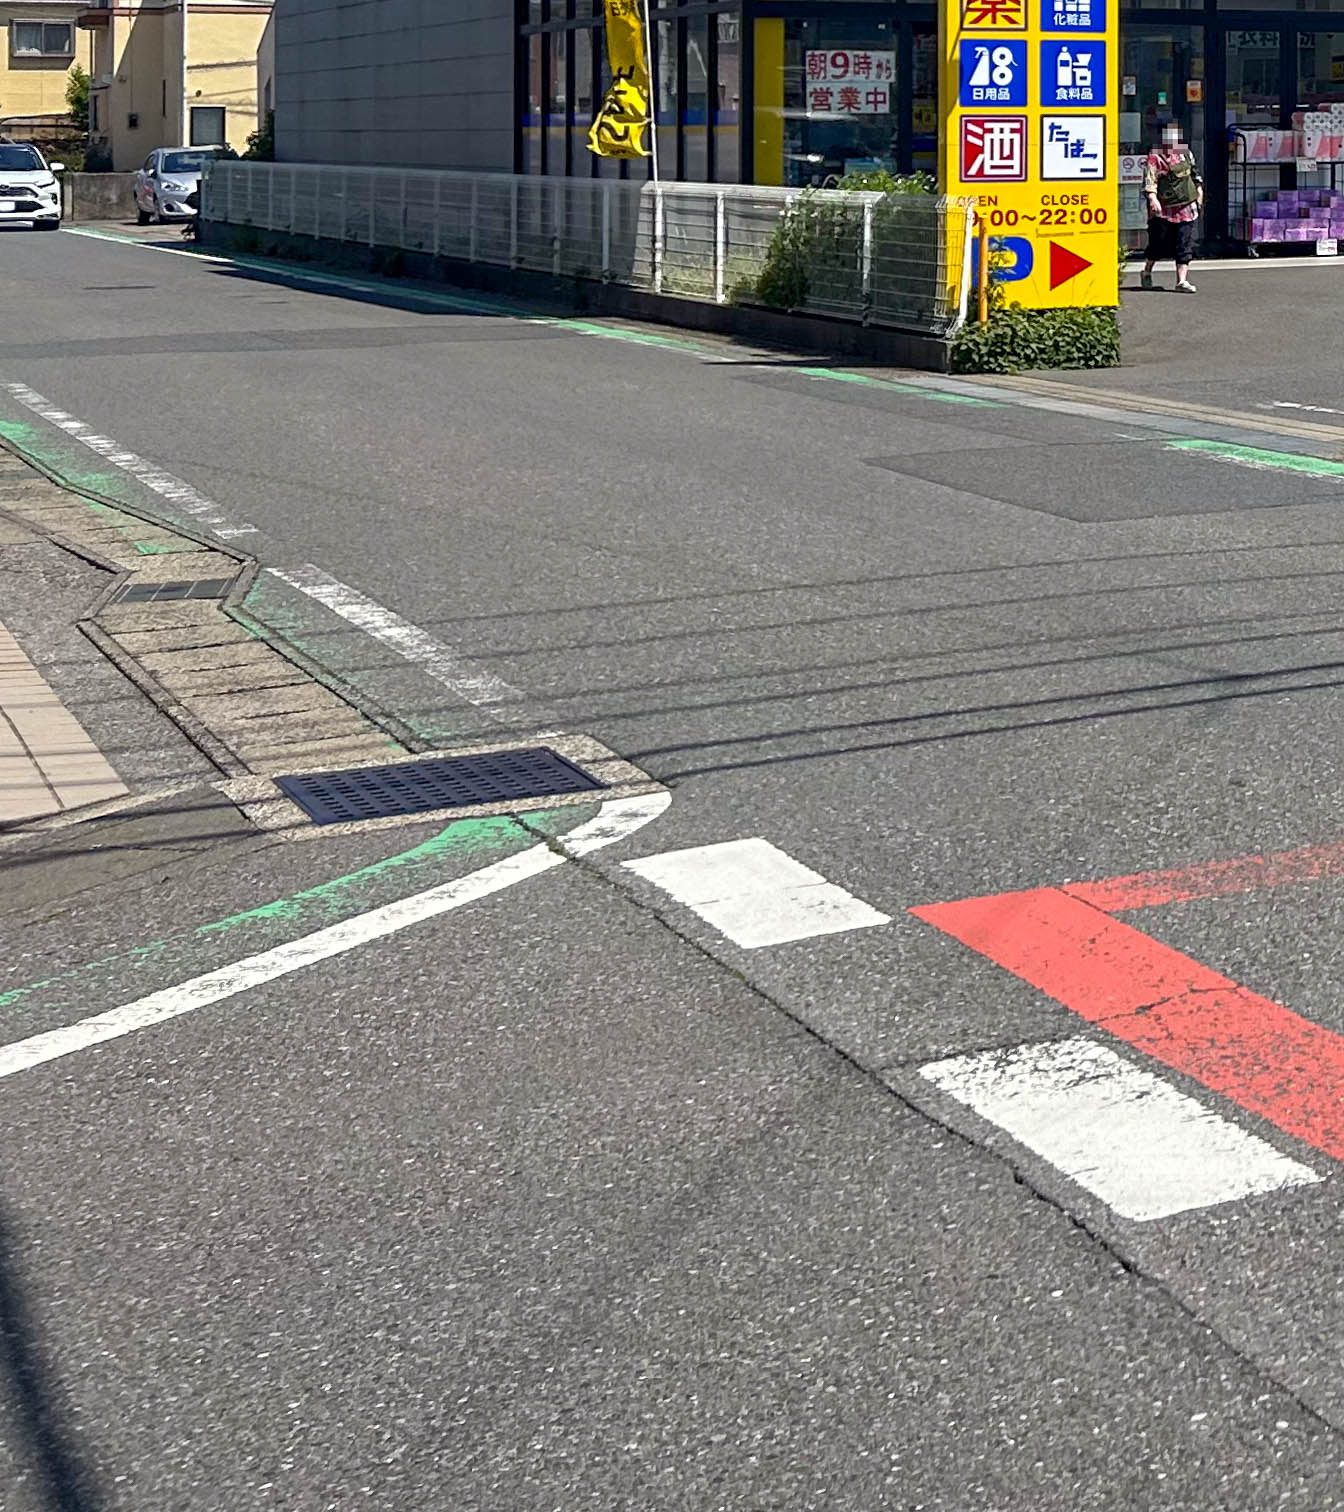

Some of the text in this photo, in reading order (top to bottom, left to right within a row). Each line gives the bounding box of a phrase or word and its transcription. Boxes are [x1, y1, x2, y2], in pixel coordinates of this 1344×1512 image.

[1053, 13, 1091, 26] 化粧品
[806, 51, 893, 80] 朝9時から
[809, 87, 887, 112] 営業中
[972, 87, 1011, 101] 日用品
[1055, 87, 1094, 101] 食料品
[967, 121, 1022, 176] 酒
[1048, 121, 1099, 173] たばこ
[1041, 194, 1090, 206] CLOSE
